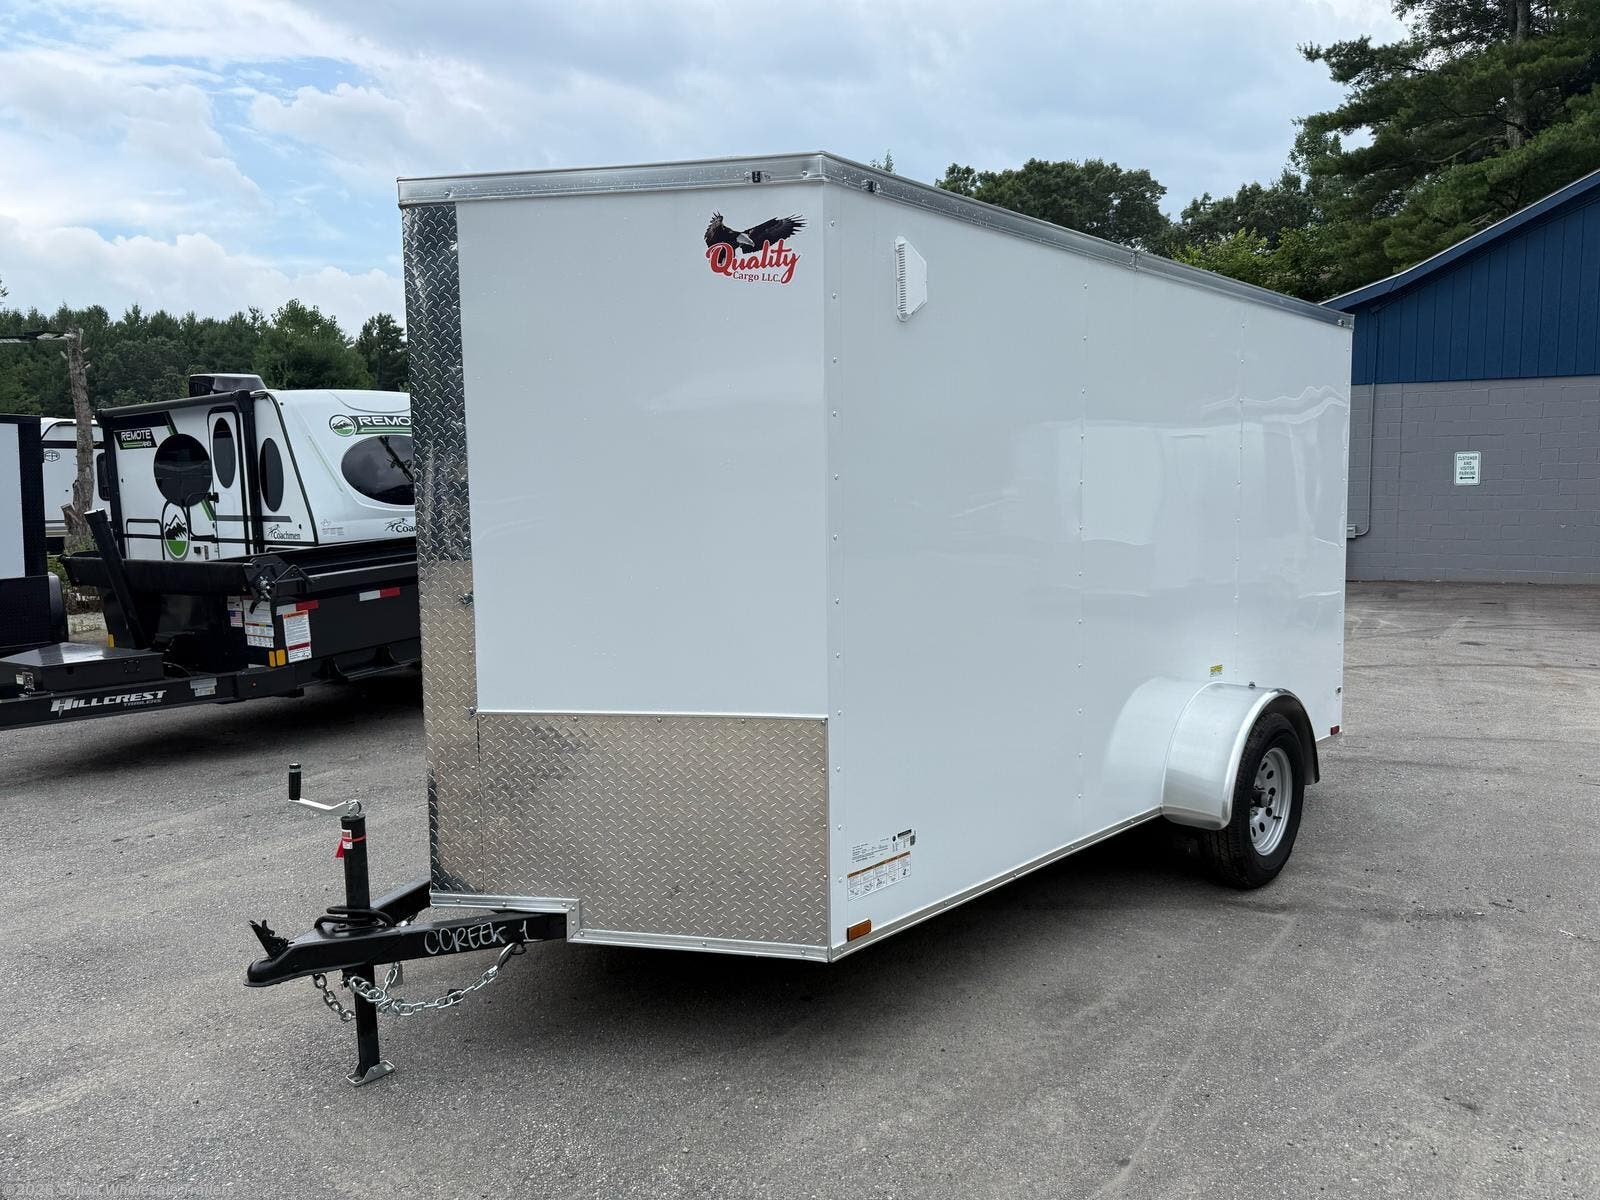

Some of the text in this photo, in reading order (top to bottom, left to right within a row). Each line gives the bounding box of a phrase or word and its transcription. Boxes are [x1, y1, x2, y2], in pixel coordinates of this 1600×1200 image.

[705, 239, 800, 284] Quality
[733, 271, 760, 283] Cargo
[357, 416, 412, 426] REMO
[120, 430, 152, 441] REMOTE
[273, 530, 301, 540] Coachmen
[50, 690, 167, 717] HILLCREST
